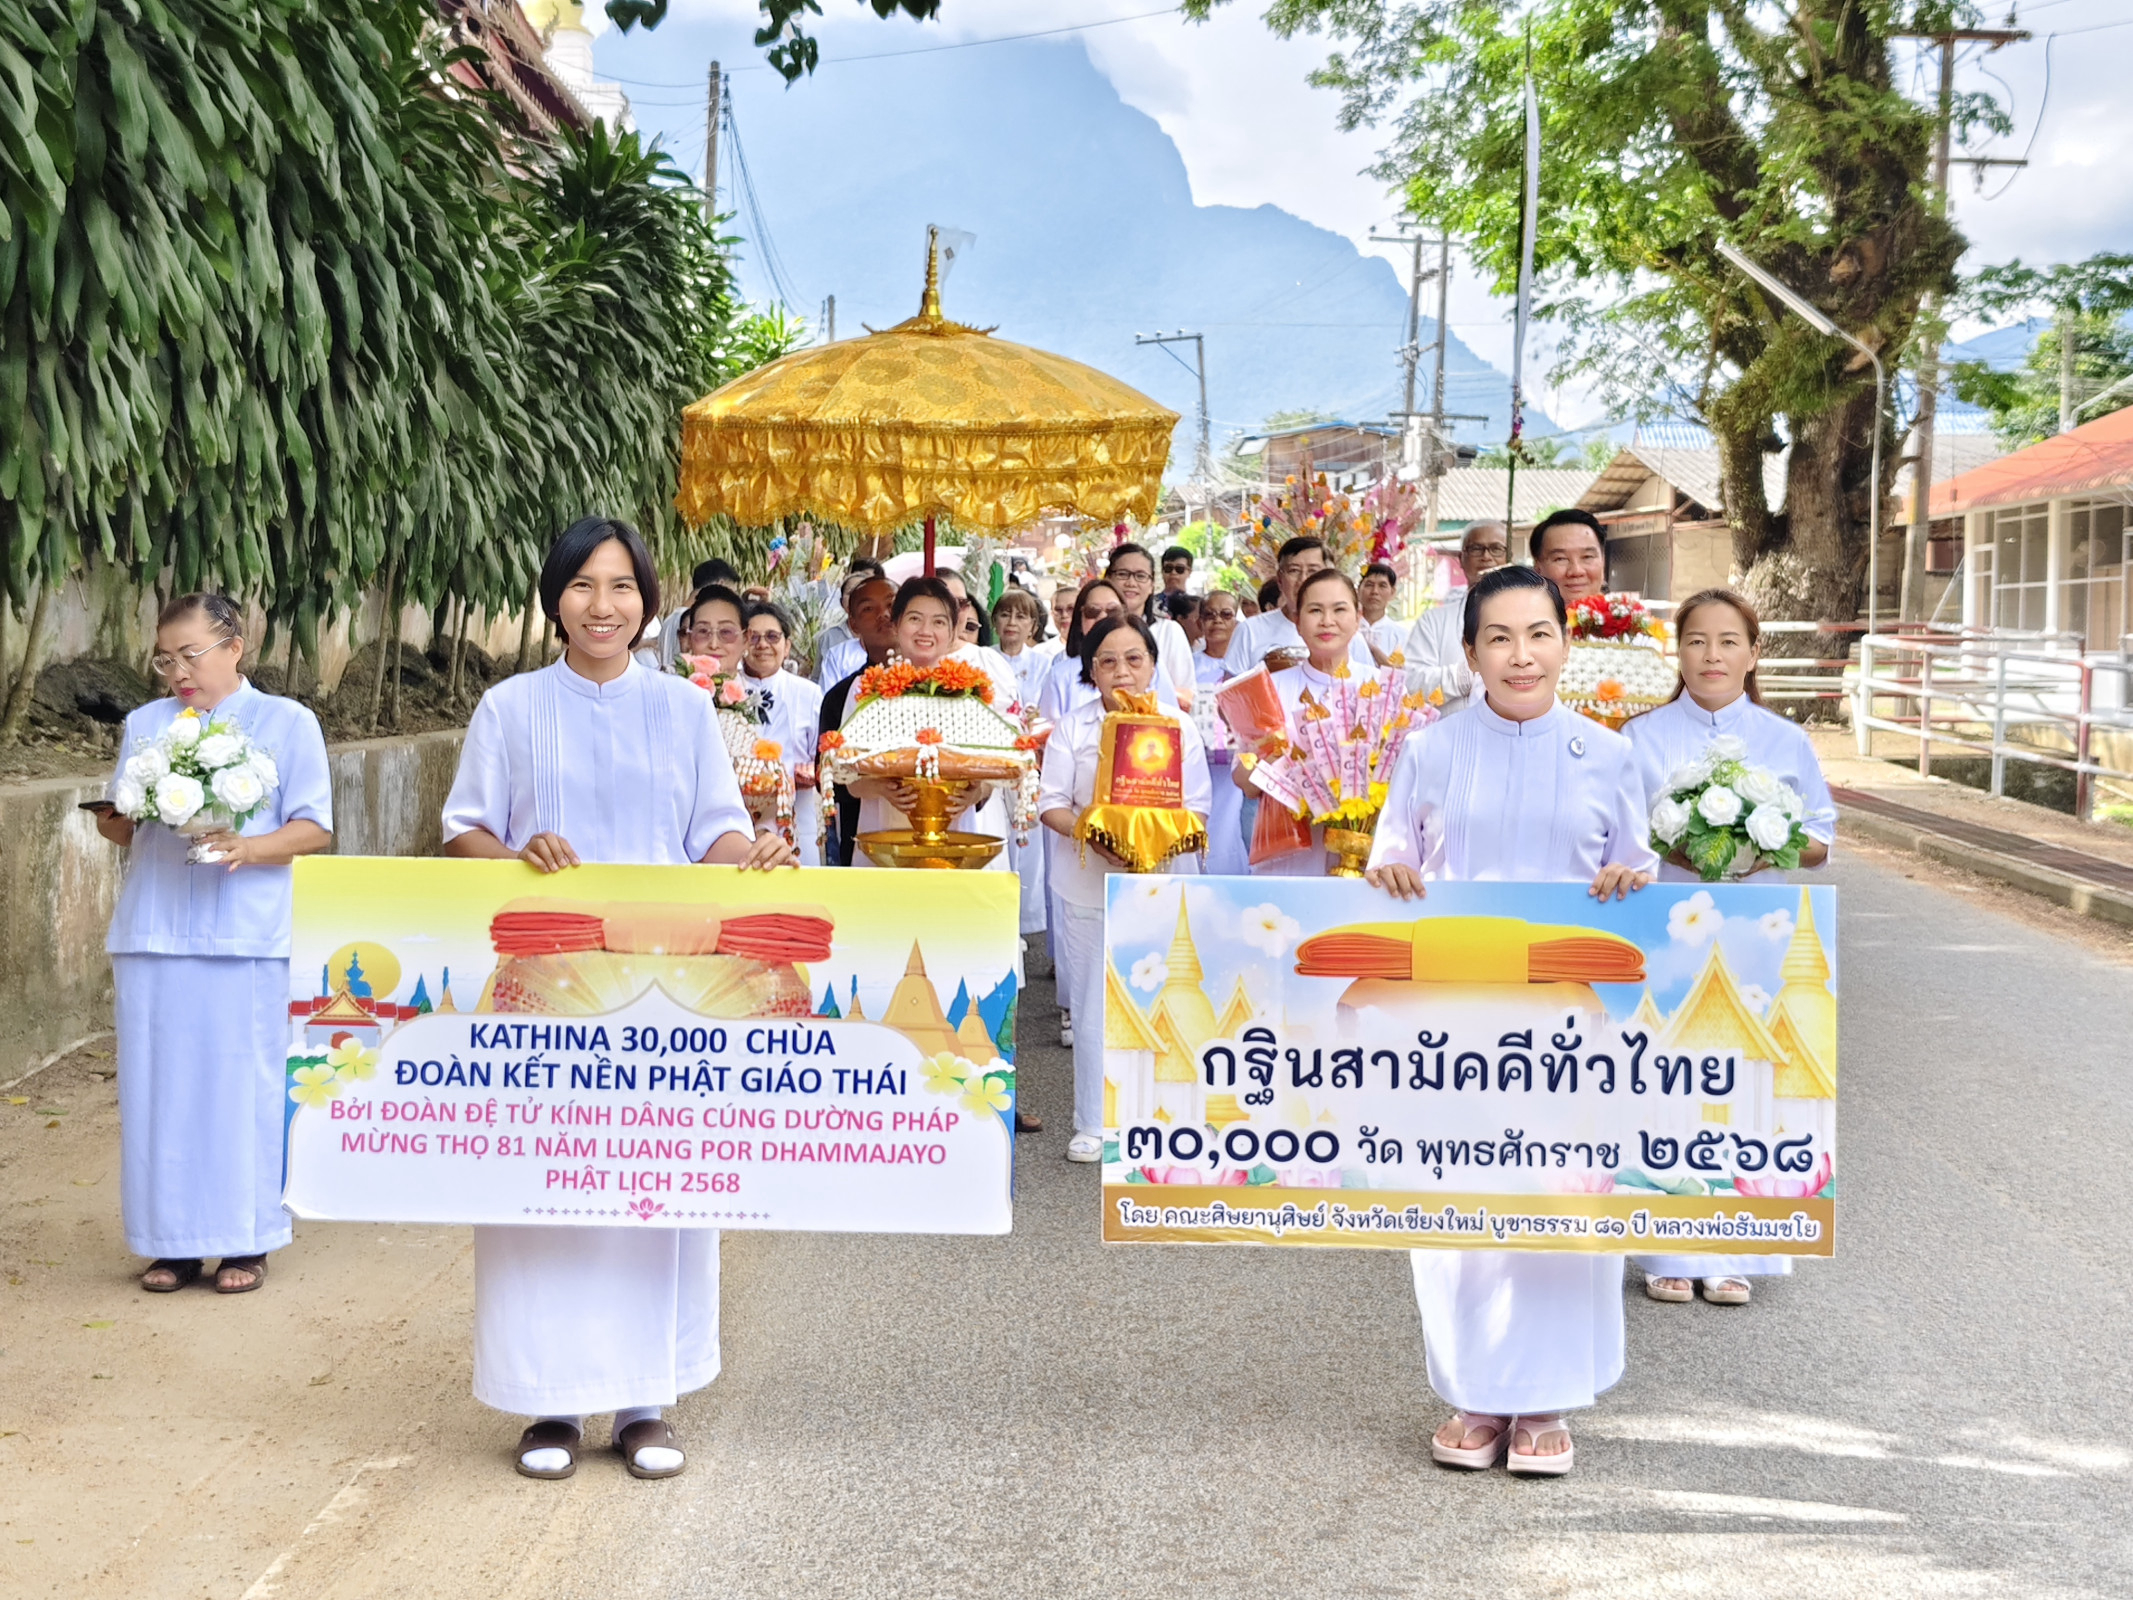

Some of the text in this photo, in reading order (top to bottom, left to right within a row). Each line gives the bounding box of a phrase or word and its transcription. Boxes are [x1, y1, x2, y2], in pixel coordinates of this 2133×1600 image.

[470, 1022, 836, 1058] KATHINA 30,000 CHÙA
[395, 1052, 907, 1098] ĐOÀN KẾT NỀN PHẬT GIÁO THÁI
[1202, 1014, 1735, 1106] กฐินสามัคคีทั่วไทย
[381, 1096, 457, 1123] ĐOÀN
[464, 1098, 498, 1128] ĐỆ
[506, 1095, 543, 1125] TỬ
[551, 1099, 612, 1127] KÍNH
[621, 1100, 695, 1128] DÂNG
[702, 1102, 777, 1130] CÚNG
[784, 1104, 884, 1133] DƯỜNG
[892, 1106, 960, 1133] PHÁP
[341, 1127, 947, 1166] MỪNG THỌ 81 NĂM LUANG POR DHAMMAJAYO
[1127, 1125, 1814, 1180] ๓๐,๐๐๐ วัด พุทธศักราช ๒๕๖๘
[546, 1164, 741, 1197] PHẬT LỊCH 2568
[1120, 1202, 1817, 1239] โดย คณะศิษยานุศิษย์ จังหวัดเชียงใหม่ บูชาธรรม ๘๑ ปี หลวงพ่อธัมมชโย
